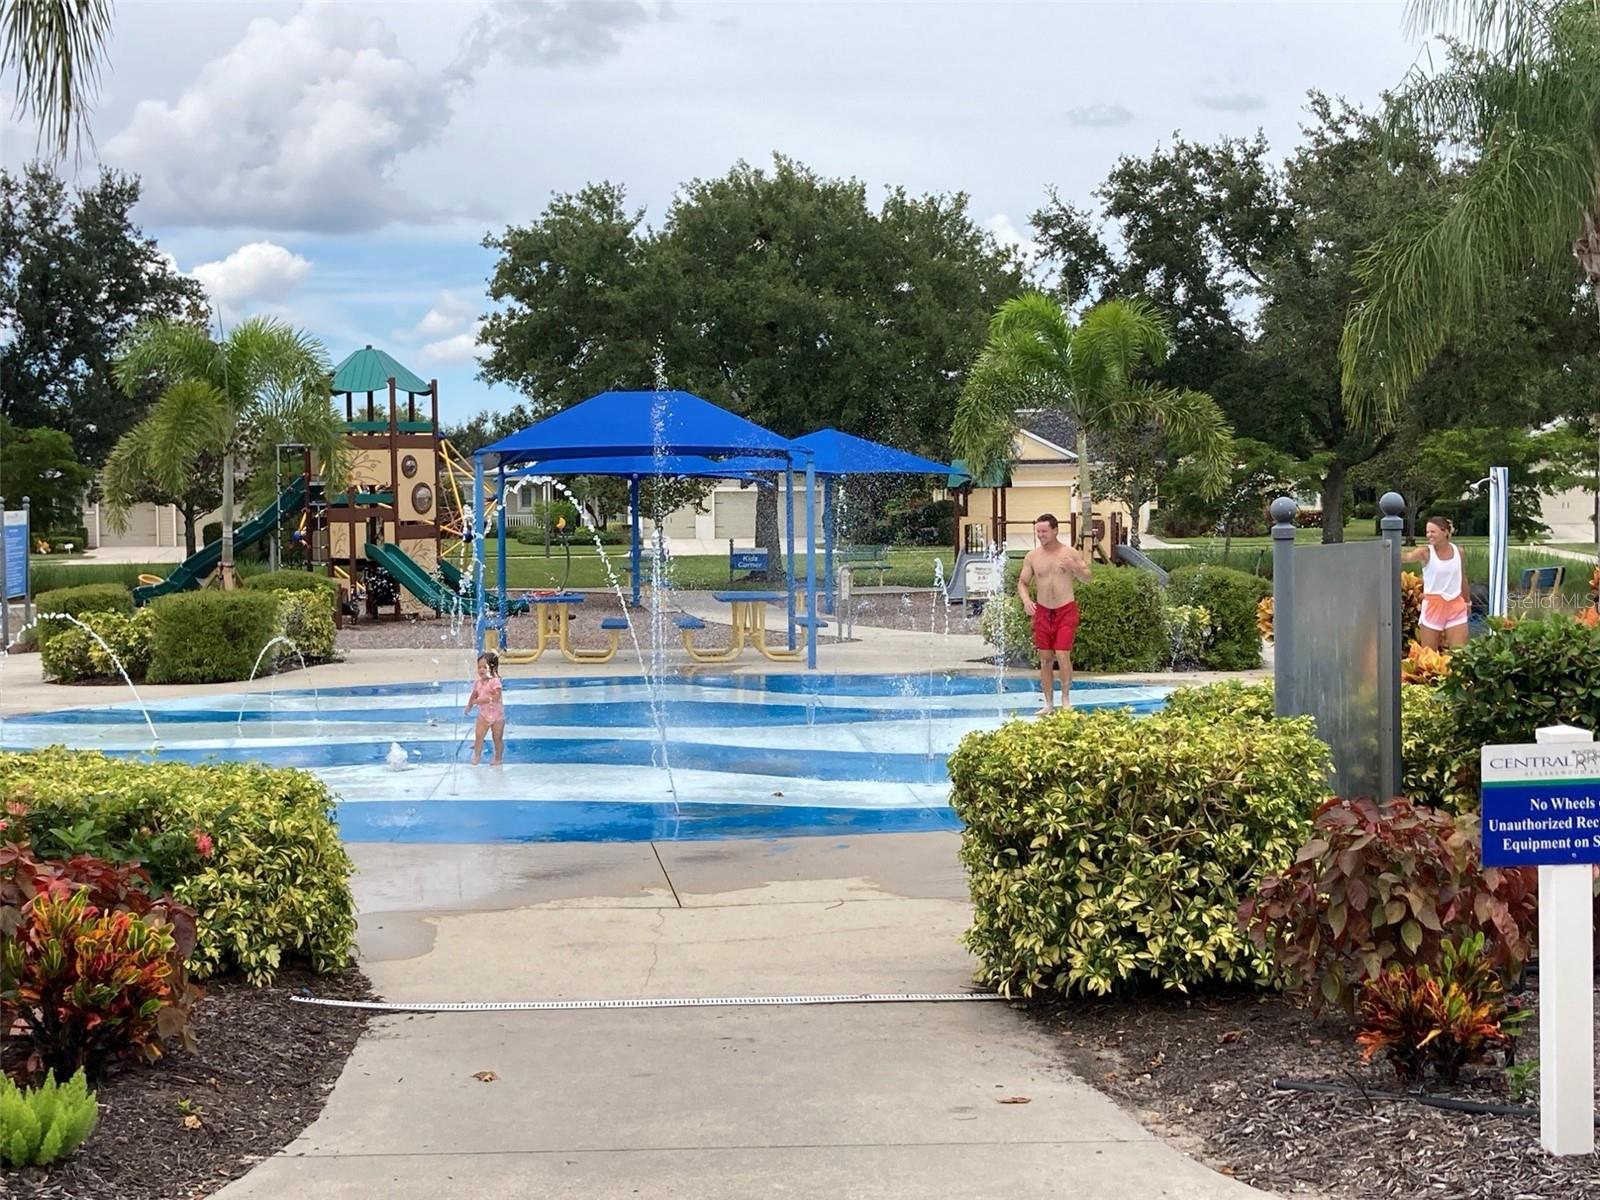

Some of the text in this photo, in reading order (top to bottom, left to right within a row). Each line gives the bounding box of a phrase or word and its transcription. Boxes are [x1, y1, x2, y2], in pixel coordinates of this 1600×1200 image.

[1489, 755, 1574, 769] CENTRAL
[1530, 798, 1548, 811] No
[1550, 796, 1596, 810] Wheels
[1488, 816, 1573, 832] Unauthorized
[1503, 836, 1571, 853] Equipment
[1574, 838, 1590, 848] on
